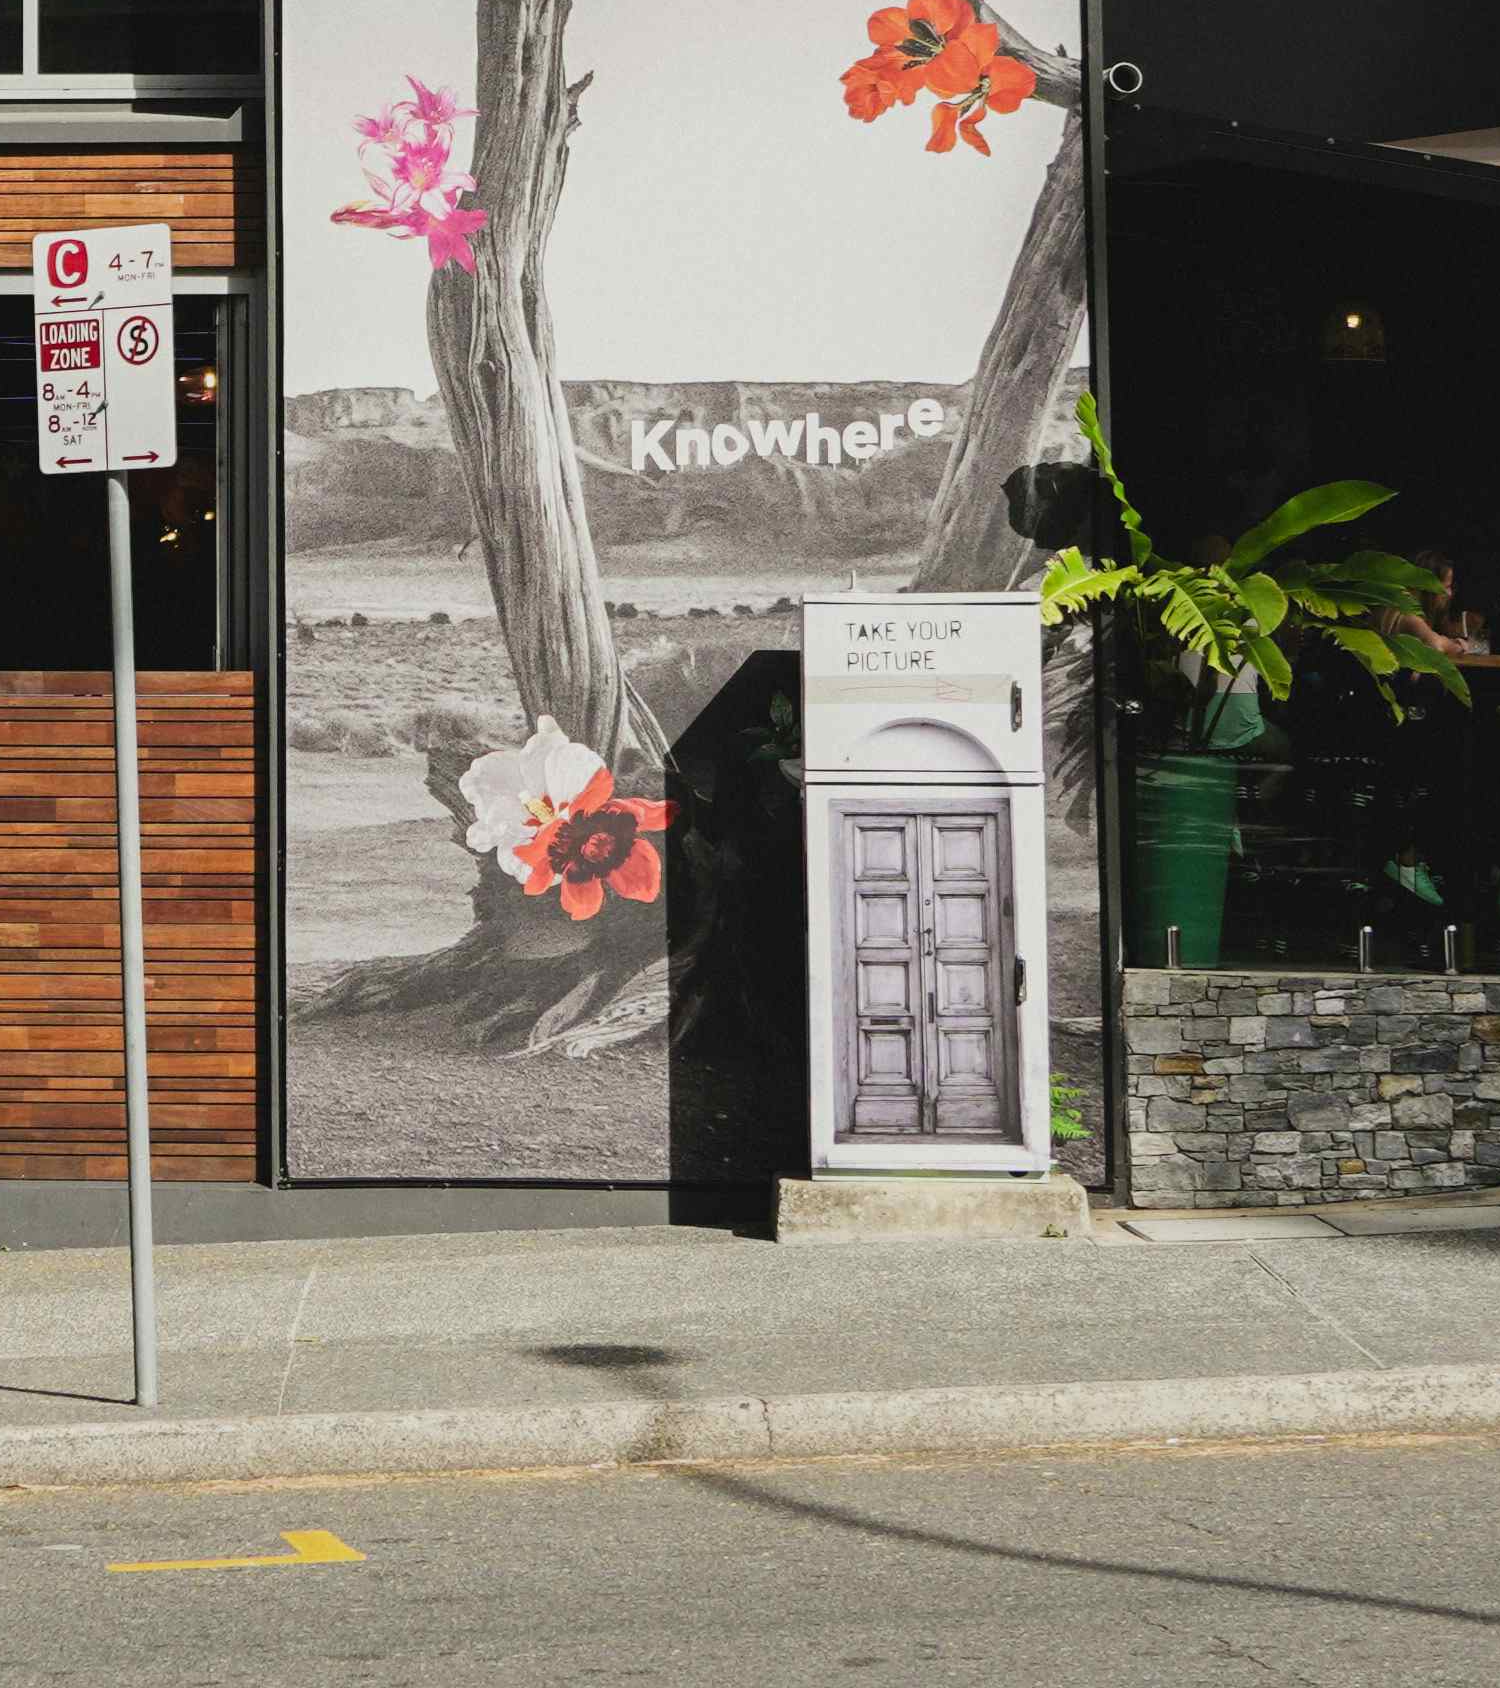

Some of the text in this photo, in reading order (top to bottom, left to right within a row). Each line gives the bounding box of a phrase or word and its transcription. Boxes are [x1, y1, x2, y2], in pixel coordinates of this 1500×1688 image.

[55, 243, 80, 284] C
[41, 321, 98, 345] LOADING
[50, 347, 91, 370] ZONE
[63, 434, 82, 446] SAT
[631, 398, 944, 474] Knowhere
[844, 620, 962, 641] TAKE YOUR
[847, 650, 937, 672] PICTURE
